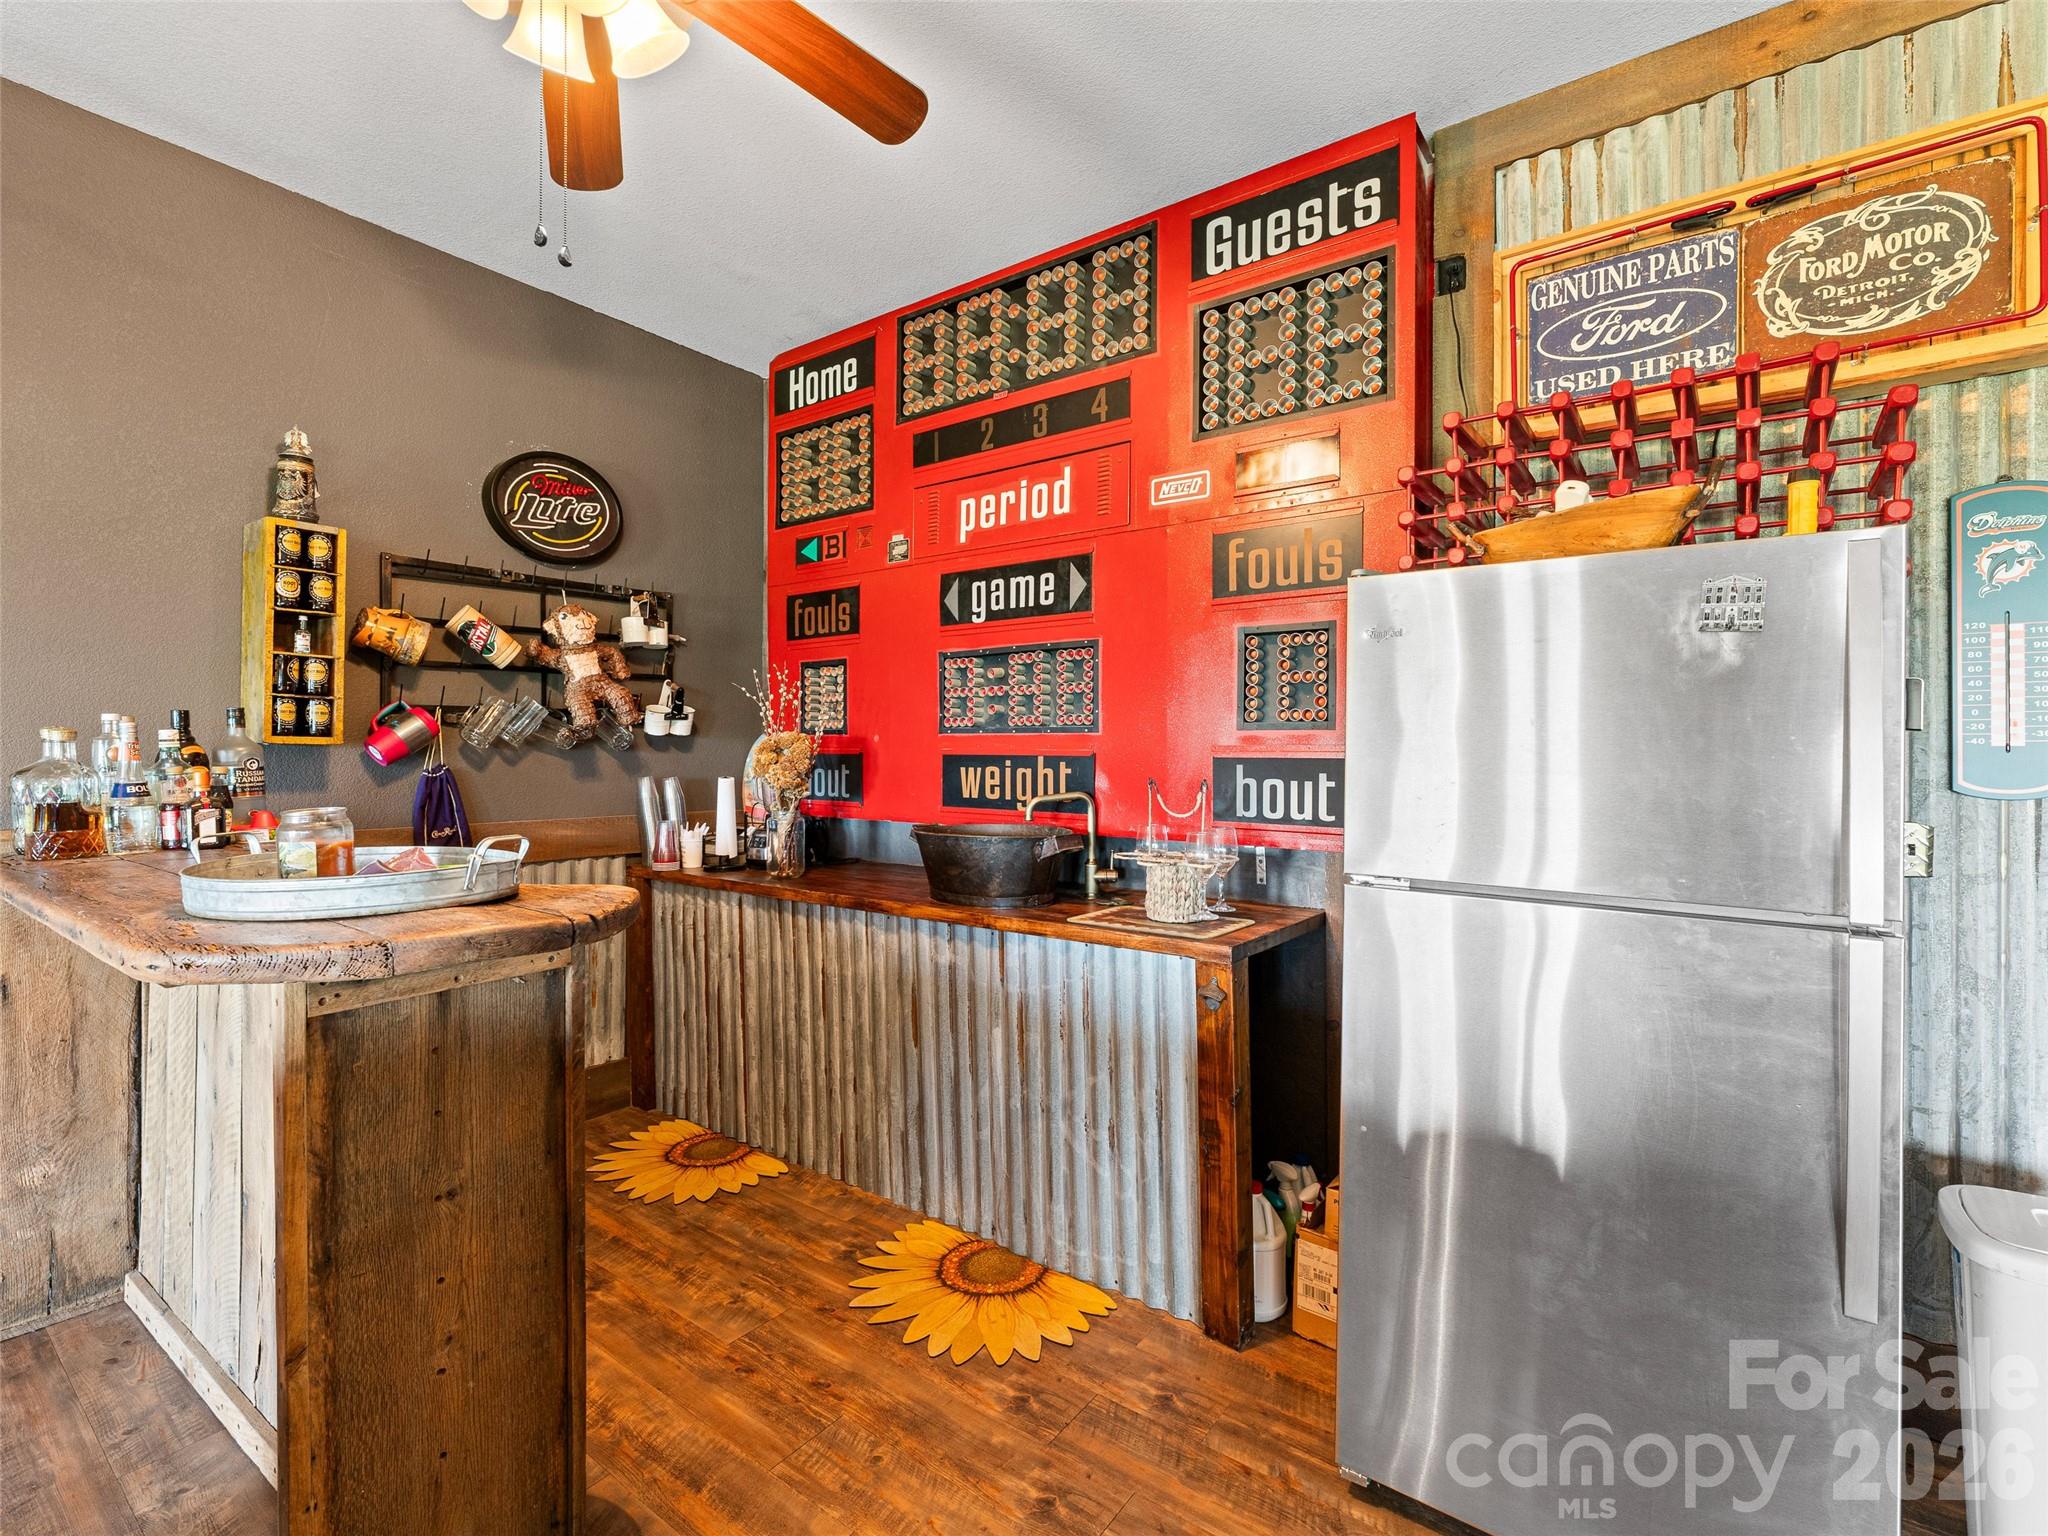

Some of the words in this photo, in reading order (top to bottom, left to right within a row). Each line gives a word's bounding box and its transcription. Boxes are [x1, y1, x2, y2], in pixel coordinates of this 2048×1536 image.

[1205, 177, 1381, 276] Guests
[1800, 251, 1859, 283] FORD
[1847, 222, 1951, 279] MOTOR
[1531, 259, 1641, 312] GENUINE
[1648, 234, 1735, 284] PARTS
[1813, 272, 1914, 299] DETROIT,
[1889, 251, 1942, 271] CO.
[1570, 298, 1688, 352] Ford
[789, 357, 858, 411] Home
[1534, 365, 1621, 399] USED
[934, 431, 939, 462] 1
[980, 417, 994, 451] 2
[1032, 403, 1048, 438] 3
[1091, 387, 1108, 422] 4
[530, 473, 595, 496] Miller
[960, 465, 1071, 544] period
[1158, 477, 1204, 499] NEVCO
[510, 493, 601, 529] Lite
[1967, 511, 2047, 533] Dolphins
[1228, 527, 1343, 592] fouls
[794, 594, 850, 637] fouls
[971, 572, 1055, 623] game
[808, 764, 850, 798] out
[960, 755, 1072, 812] weight
[1235, 764, 1336, 822] bout
